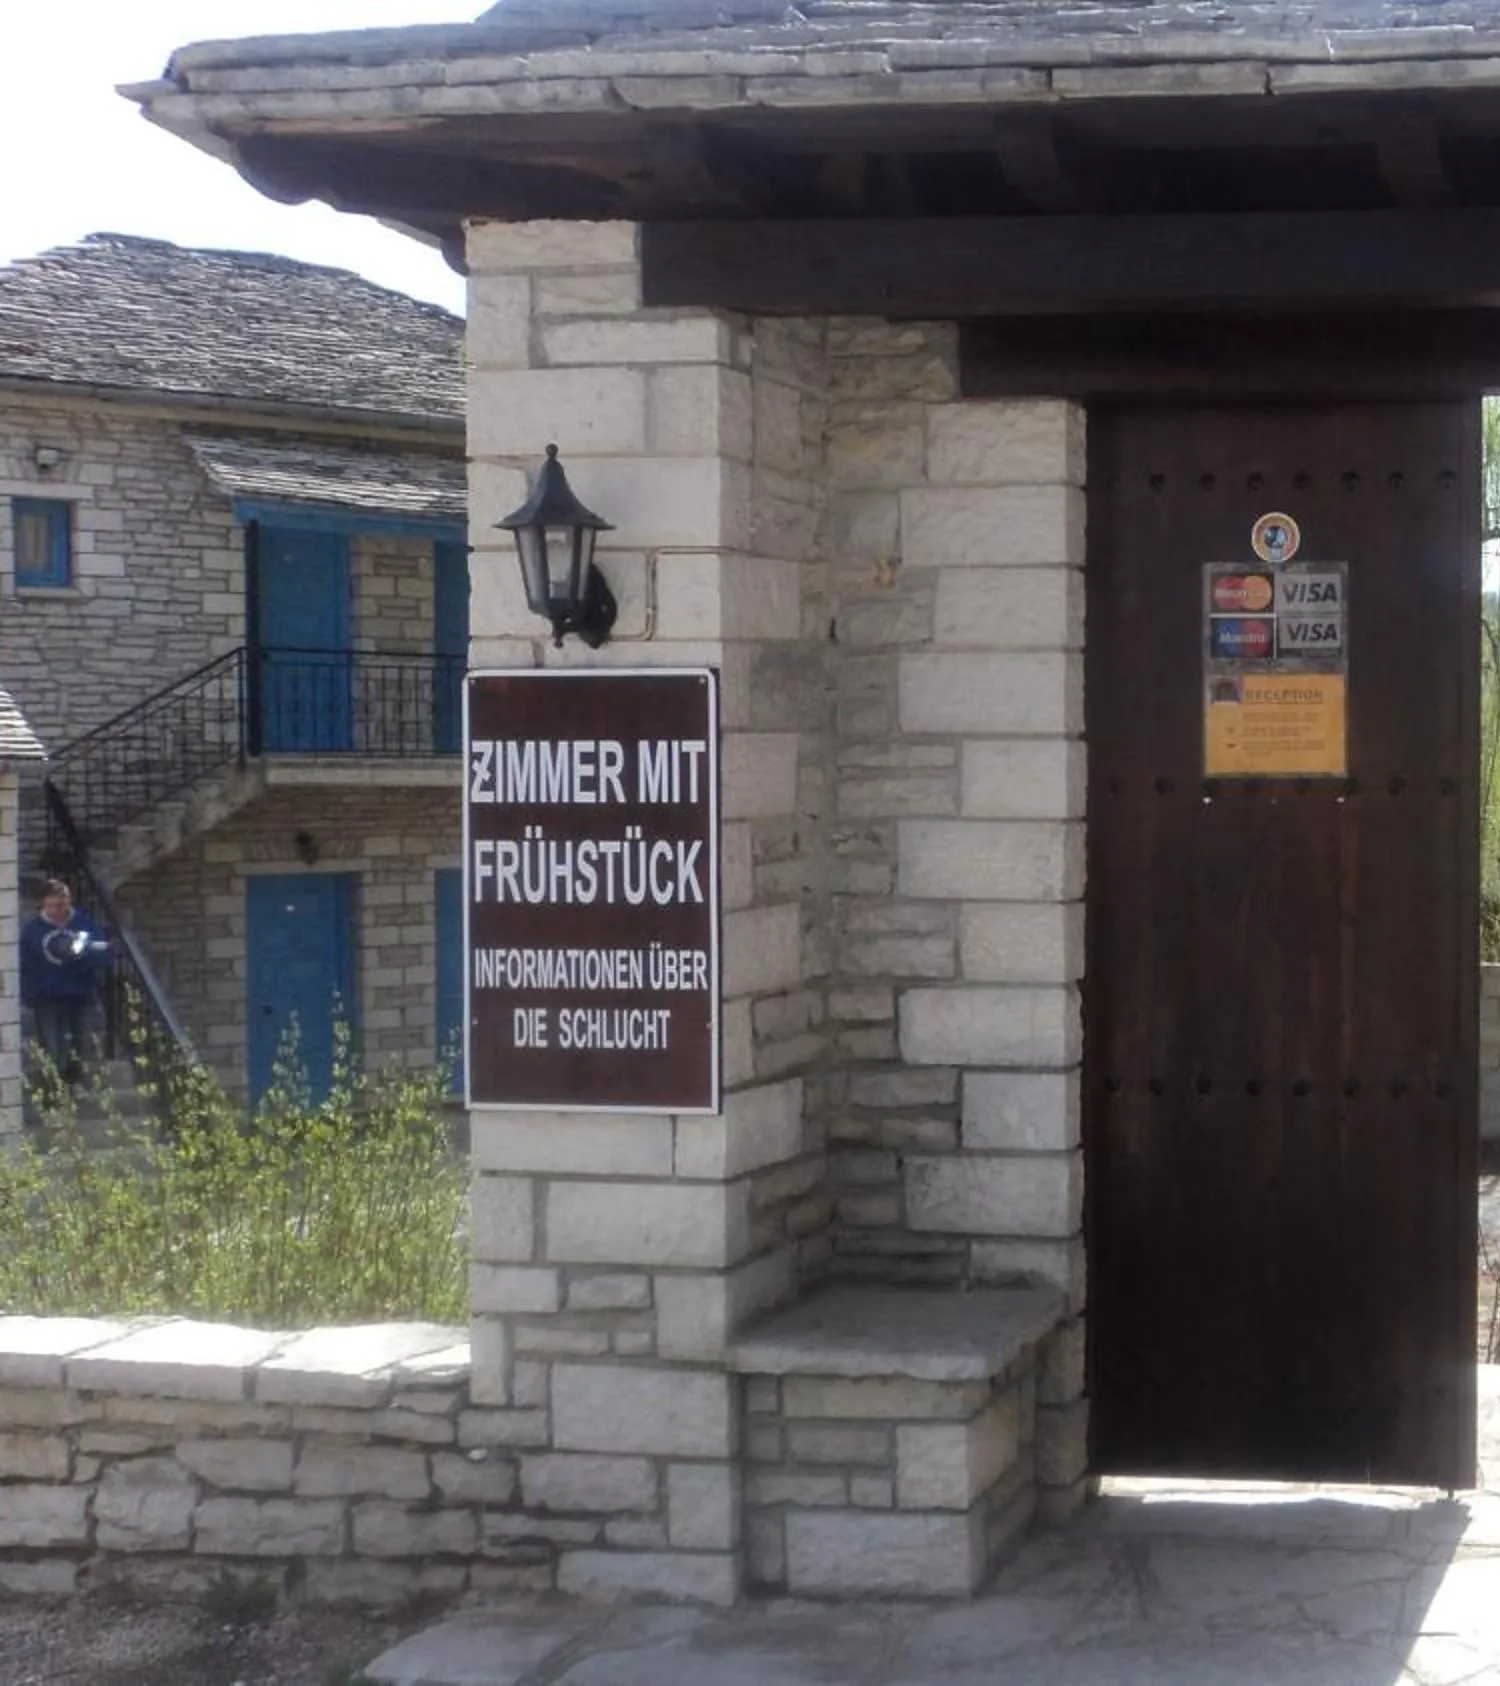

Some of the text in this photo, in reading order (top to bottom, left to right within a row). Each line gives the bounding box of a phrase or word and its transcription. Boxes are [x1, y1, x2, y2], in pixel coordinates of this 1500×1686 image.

[1282, 582, 1338, 602] VISA
[1287, 623, 1338, 641] VISA
[470, 740, 706, 803] ZIMMER MIT
[474, 825, 704, 904] FRÜHSTÜCK
[475, 941, 708, 990] INFORMATIONEN ÜBER
[513, 1008, 671, 1049] DIE SCHLUCHT
